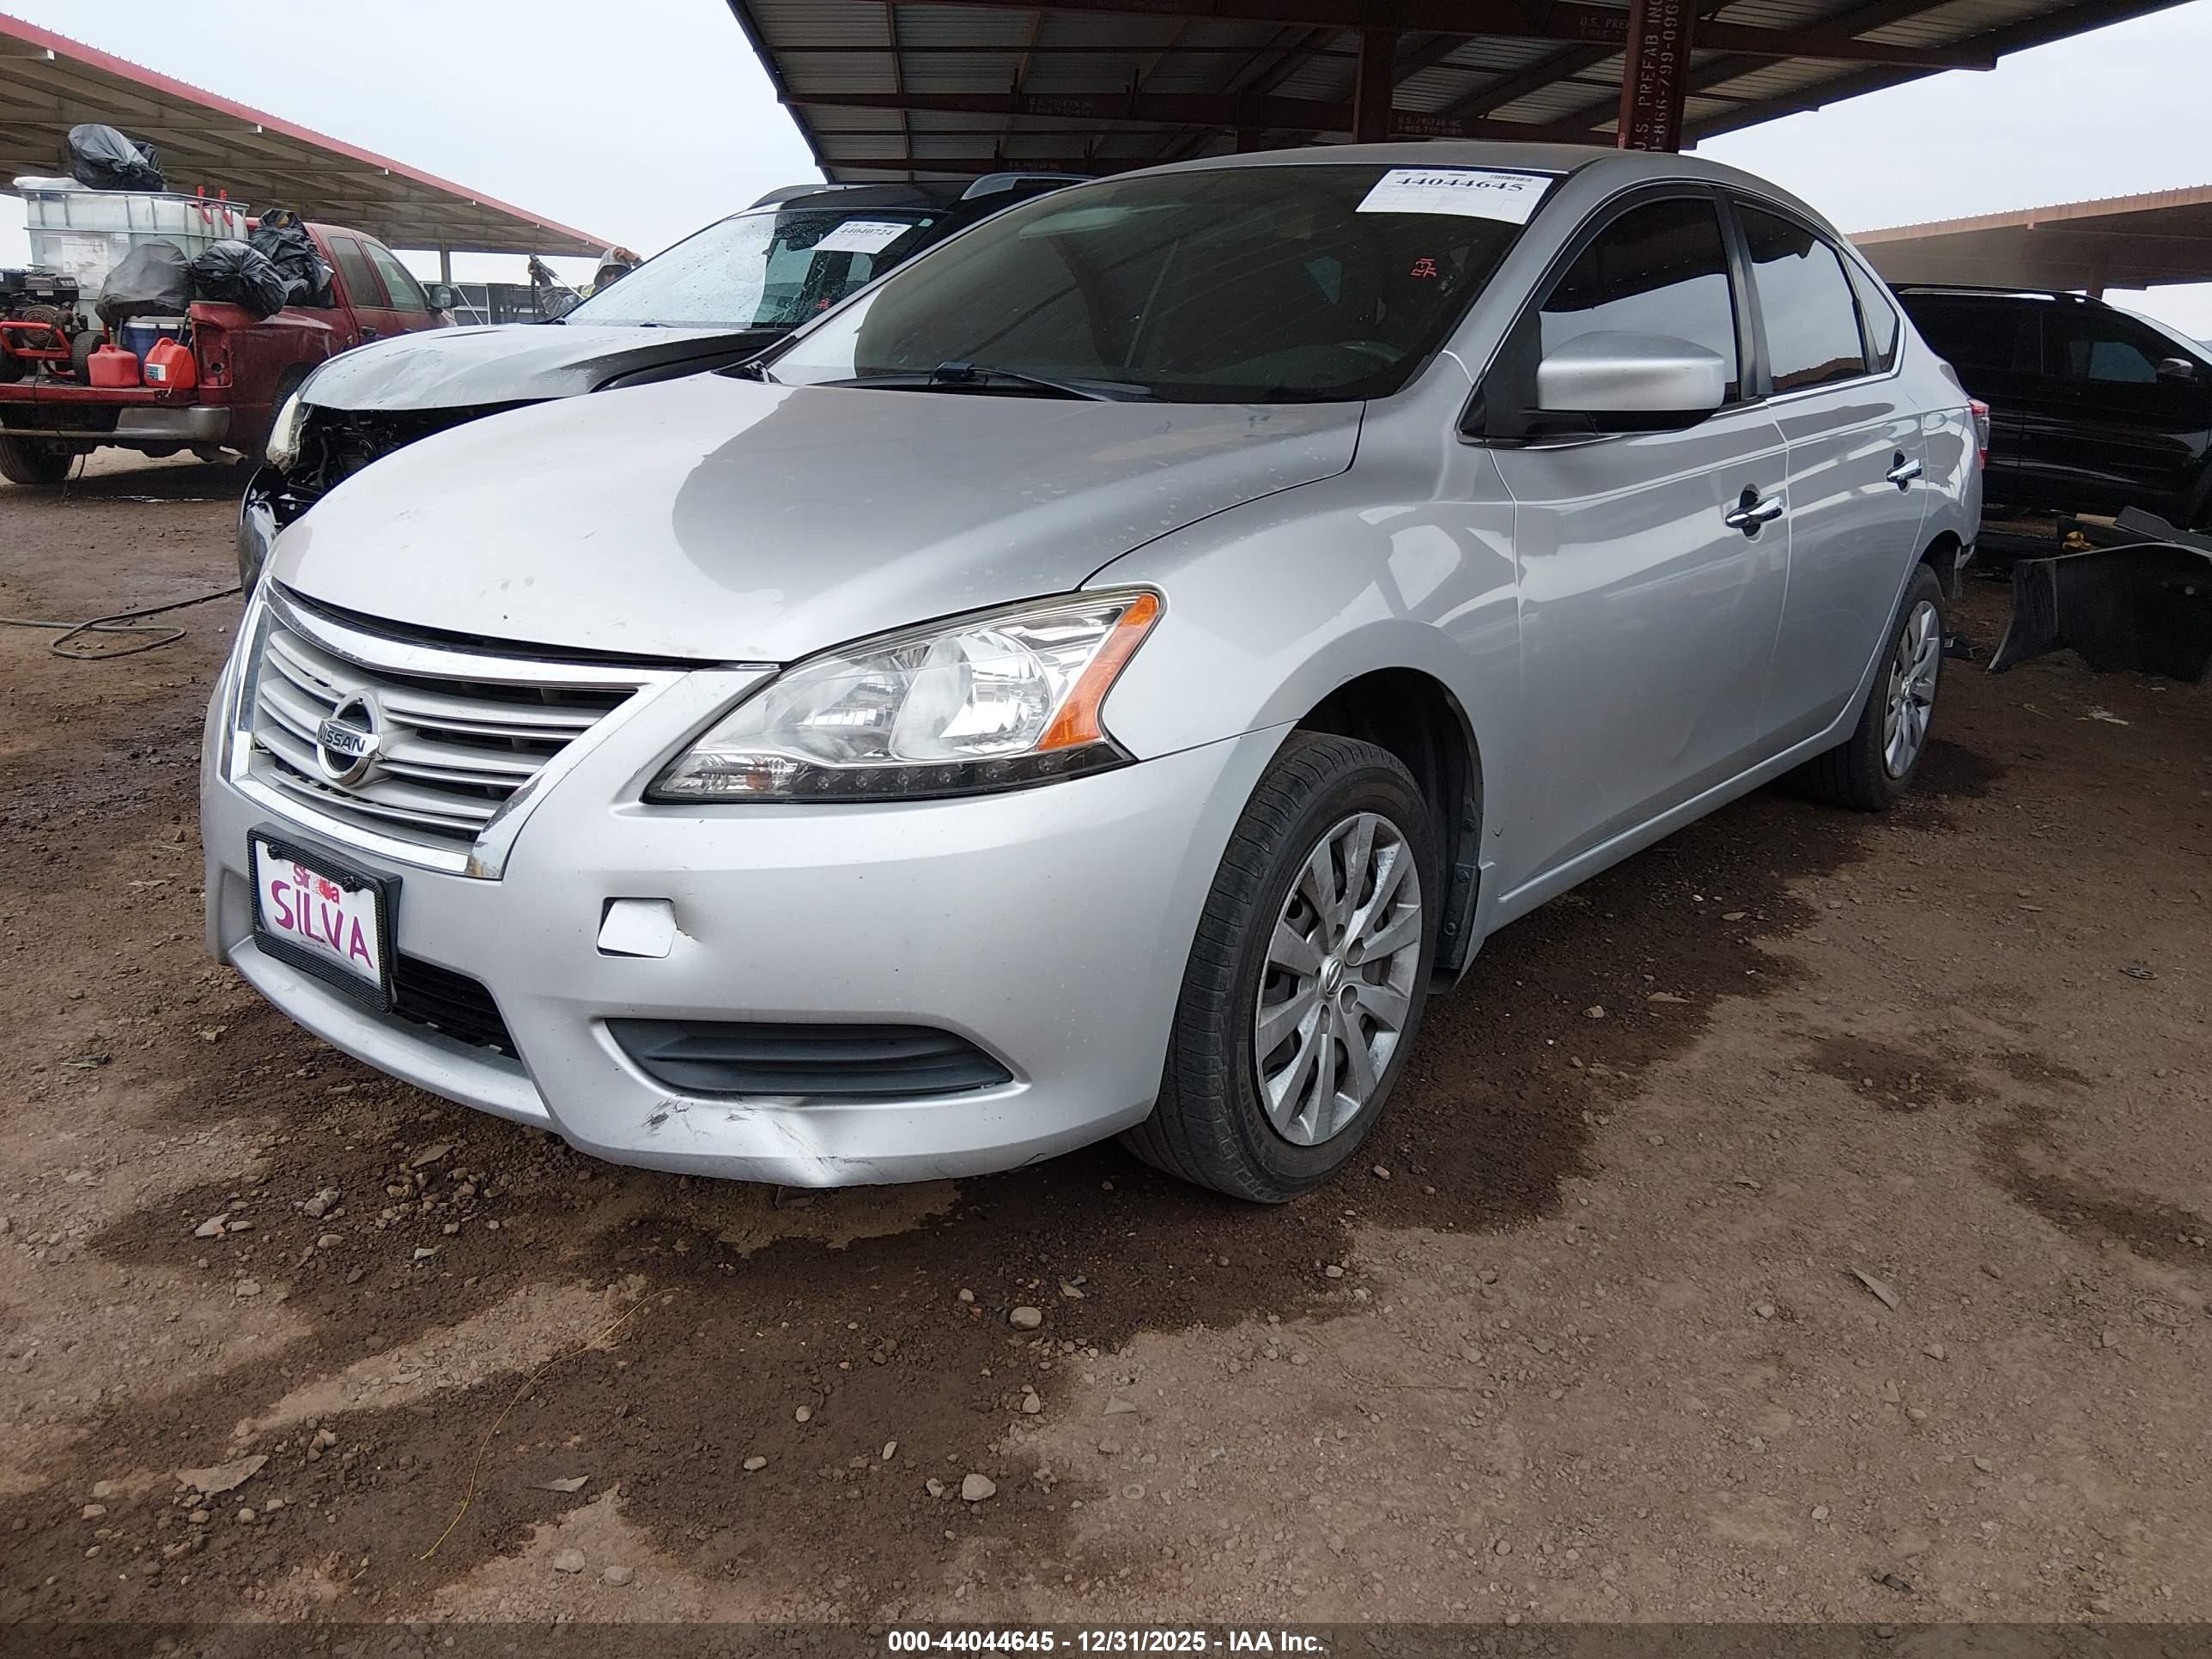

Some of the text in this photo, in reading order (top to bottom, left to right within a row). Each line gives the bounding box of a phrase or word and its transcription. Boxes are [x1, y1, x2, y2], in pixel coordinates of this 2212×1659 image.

[1638, 34, 1659, 106] PREFAB
[1650, 0, 1680, 150] 1-866-799-096
[1633, 118, 1650, 151] U.S.
[1396, 177, 1526, 192] 44044645
[318, 721, 366, 753] NISSAN
[271, 879, 374, 969] SILVA
